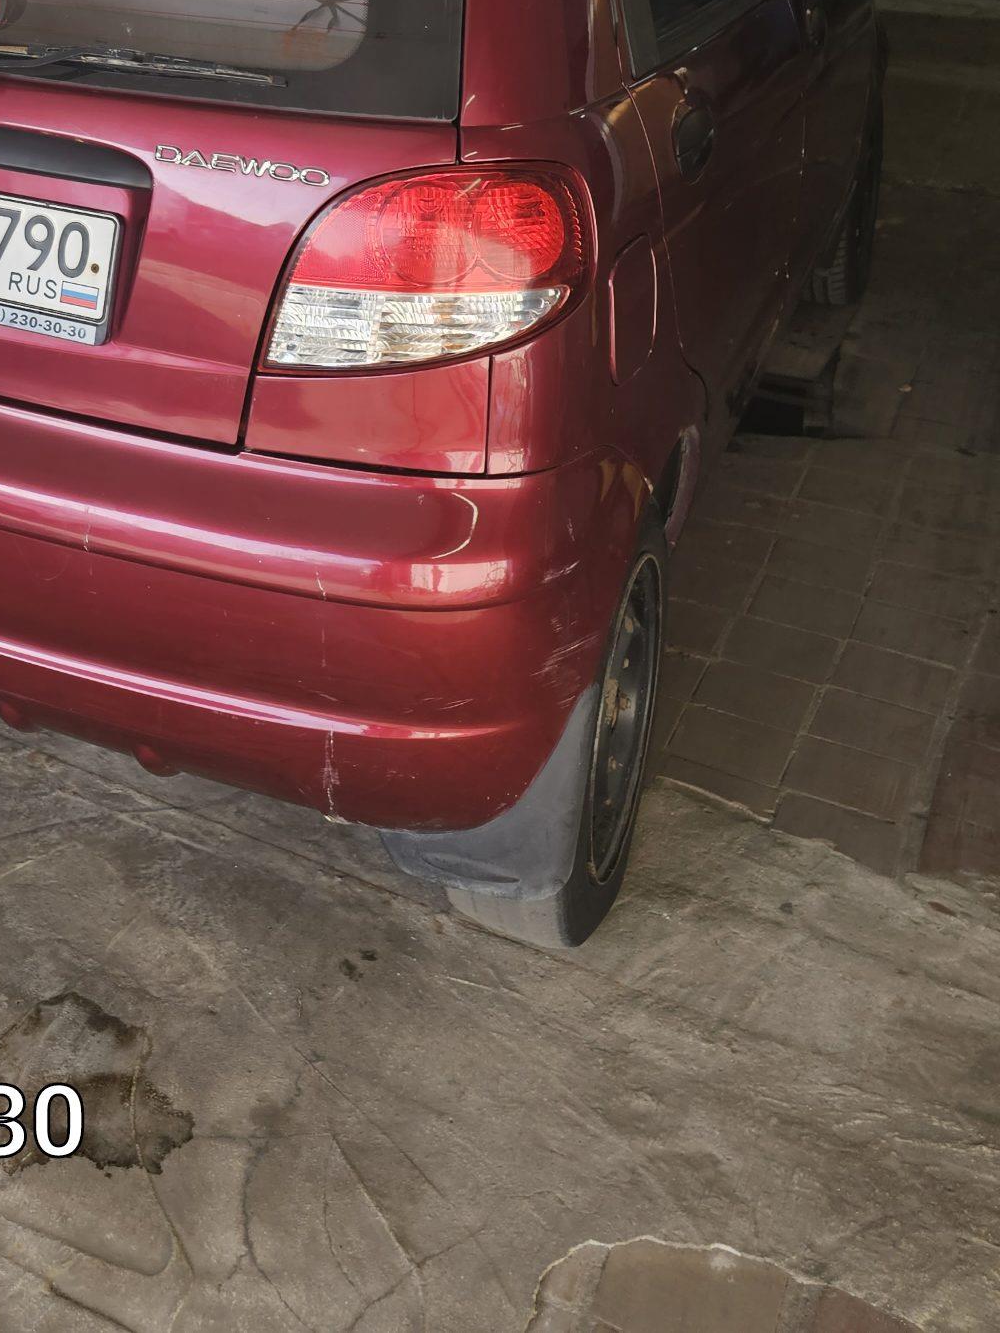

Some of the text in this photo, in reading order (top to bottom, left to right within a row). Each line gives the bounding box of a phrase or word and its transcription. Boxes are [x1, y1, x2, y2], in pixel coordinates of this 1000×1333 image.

[154, 144, 331, 187] DAEWOO
[8, 271, 58, 300] RUS
[8, 311, 87, 340] 230-30-30
